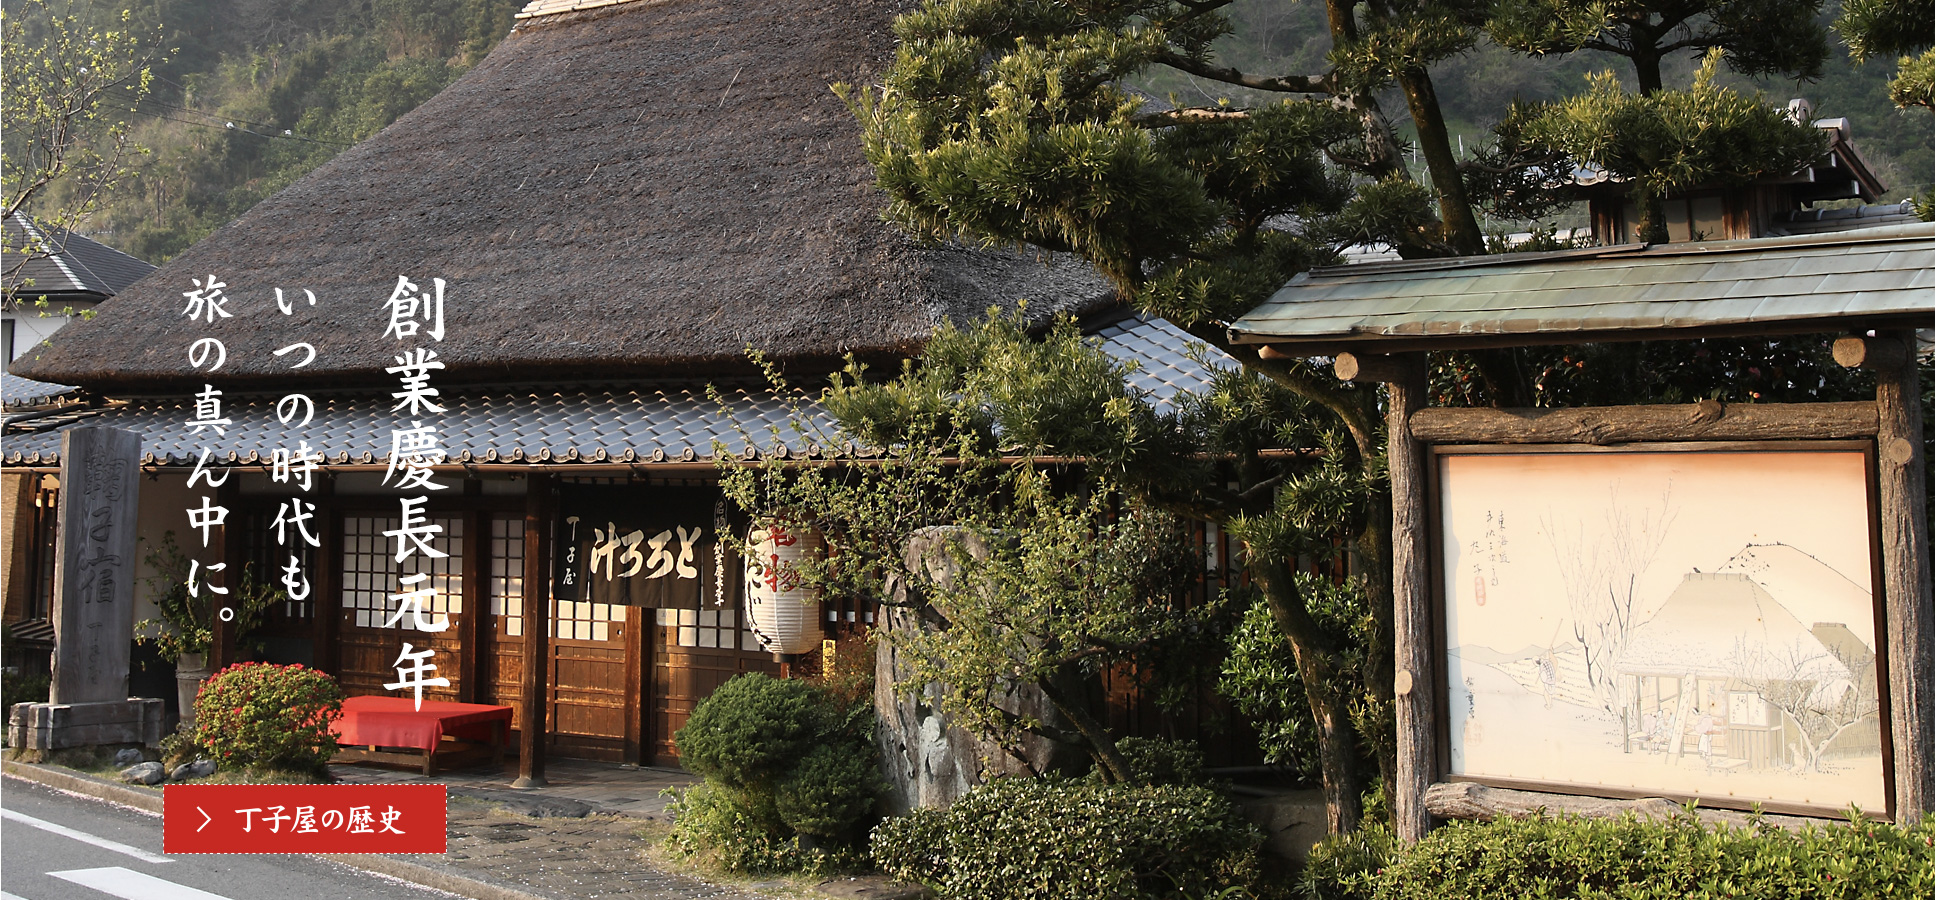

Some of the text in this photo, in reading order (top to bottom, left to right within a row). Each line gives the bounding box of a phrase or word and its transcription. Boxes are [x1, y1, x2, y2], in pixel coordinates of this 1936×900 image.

[562, 516, 580, 585] 丁子屋
[590, 521, 702, 582] とろろ汁
